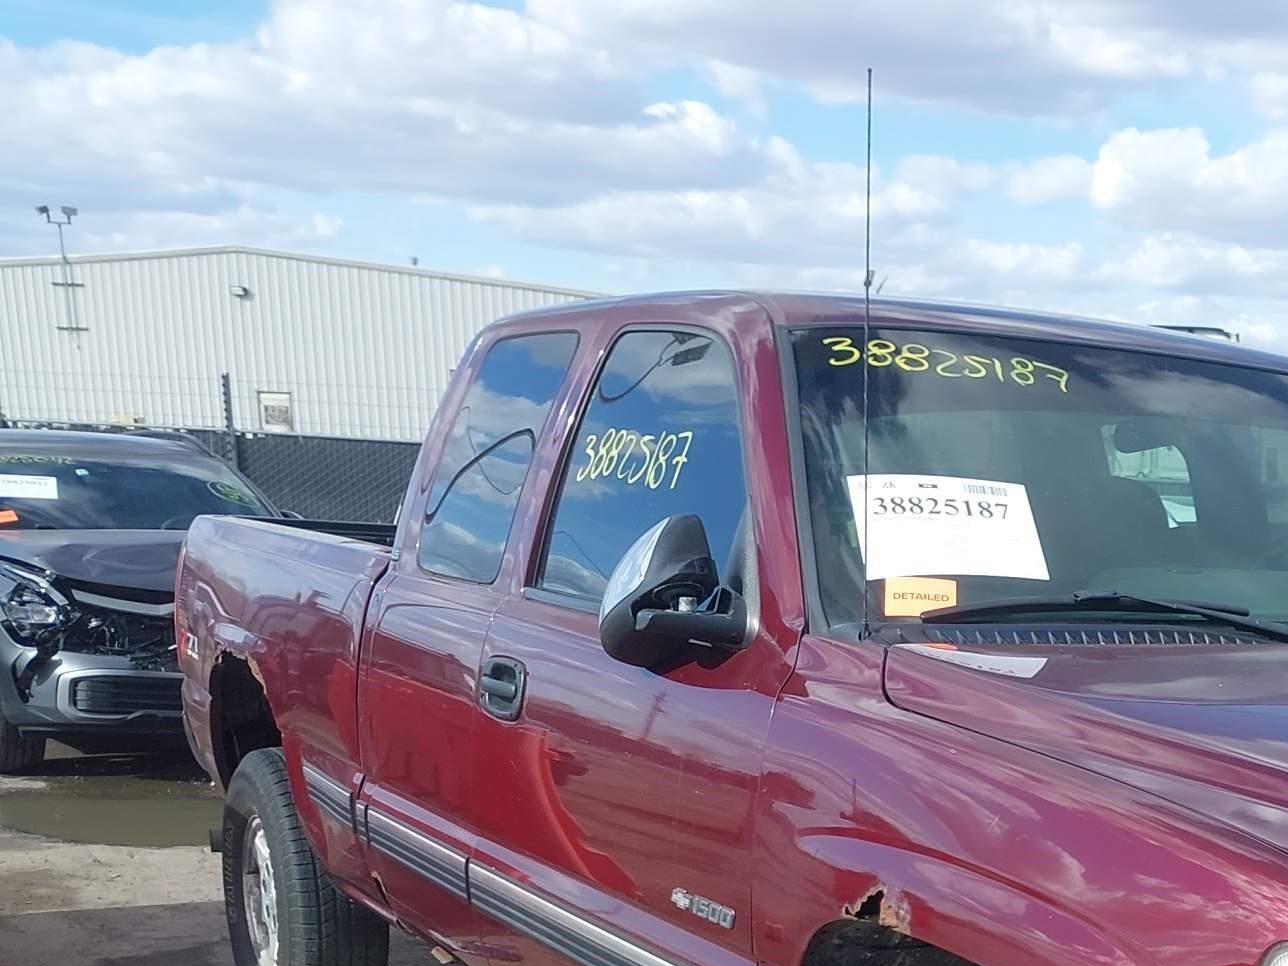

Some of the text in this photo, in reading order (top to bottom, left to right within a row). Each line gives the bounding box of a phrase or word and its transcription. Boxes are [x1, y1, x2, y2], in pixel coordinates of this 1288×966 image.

[822, 336, 1068, 393] 38825187
[576, 428, 693, 489] 38825187
[872, 496, 1009, 520] 38825187
[892, 592, 950, 602] DETAILED
[691, 894, 737, 930] 1500
